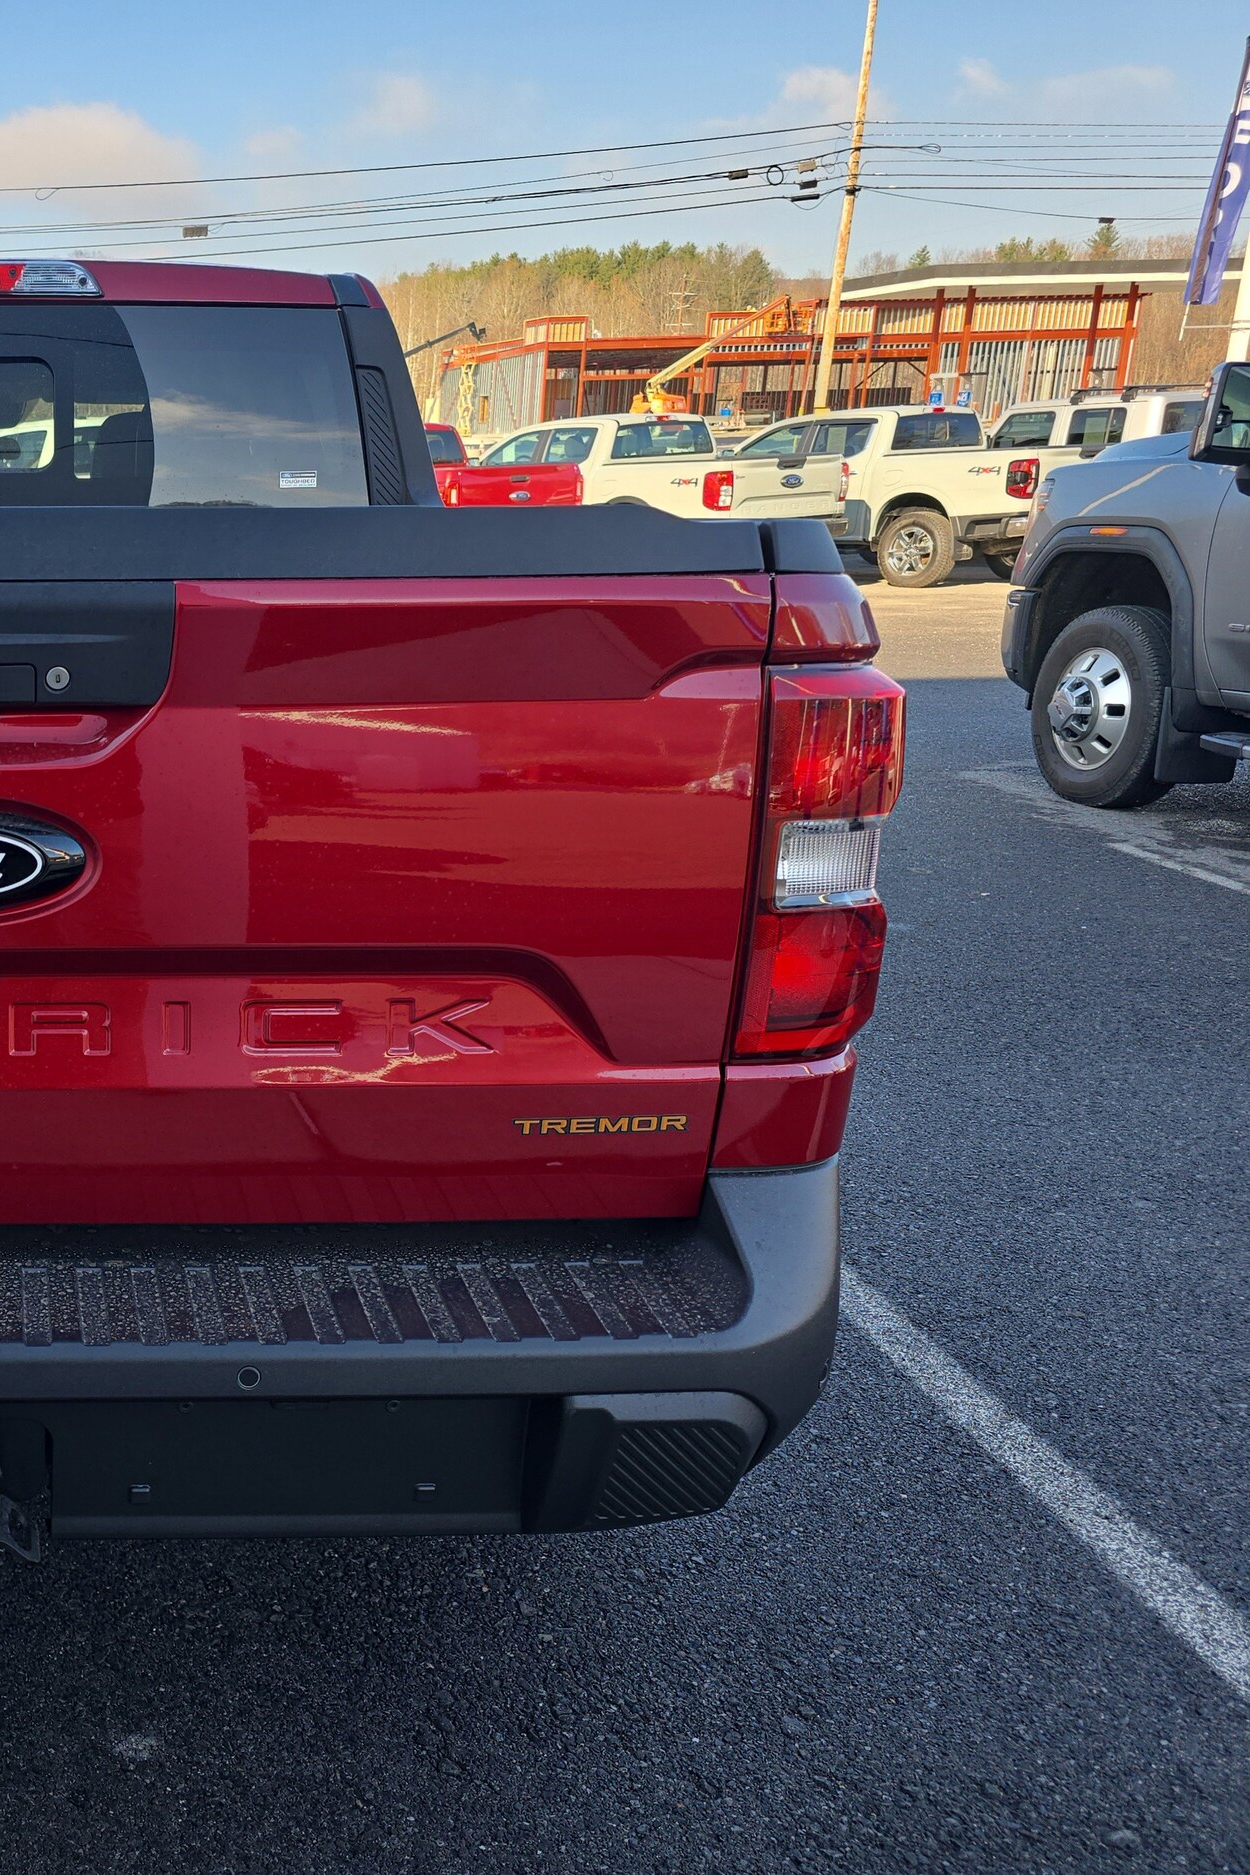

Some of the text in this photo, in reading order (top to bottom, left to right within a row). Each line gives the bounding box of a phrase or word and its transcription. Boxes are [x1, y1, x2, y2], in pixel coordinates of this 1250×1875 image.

[967, 465, 1002, 476] 4x4
[670, 477, 698, 488] 4x4
[513, 1114, 689, 1135] TREMOR
